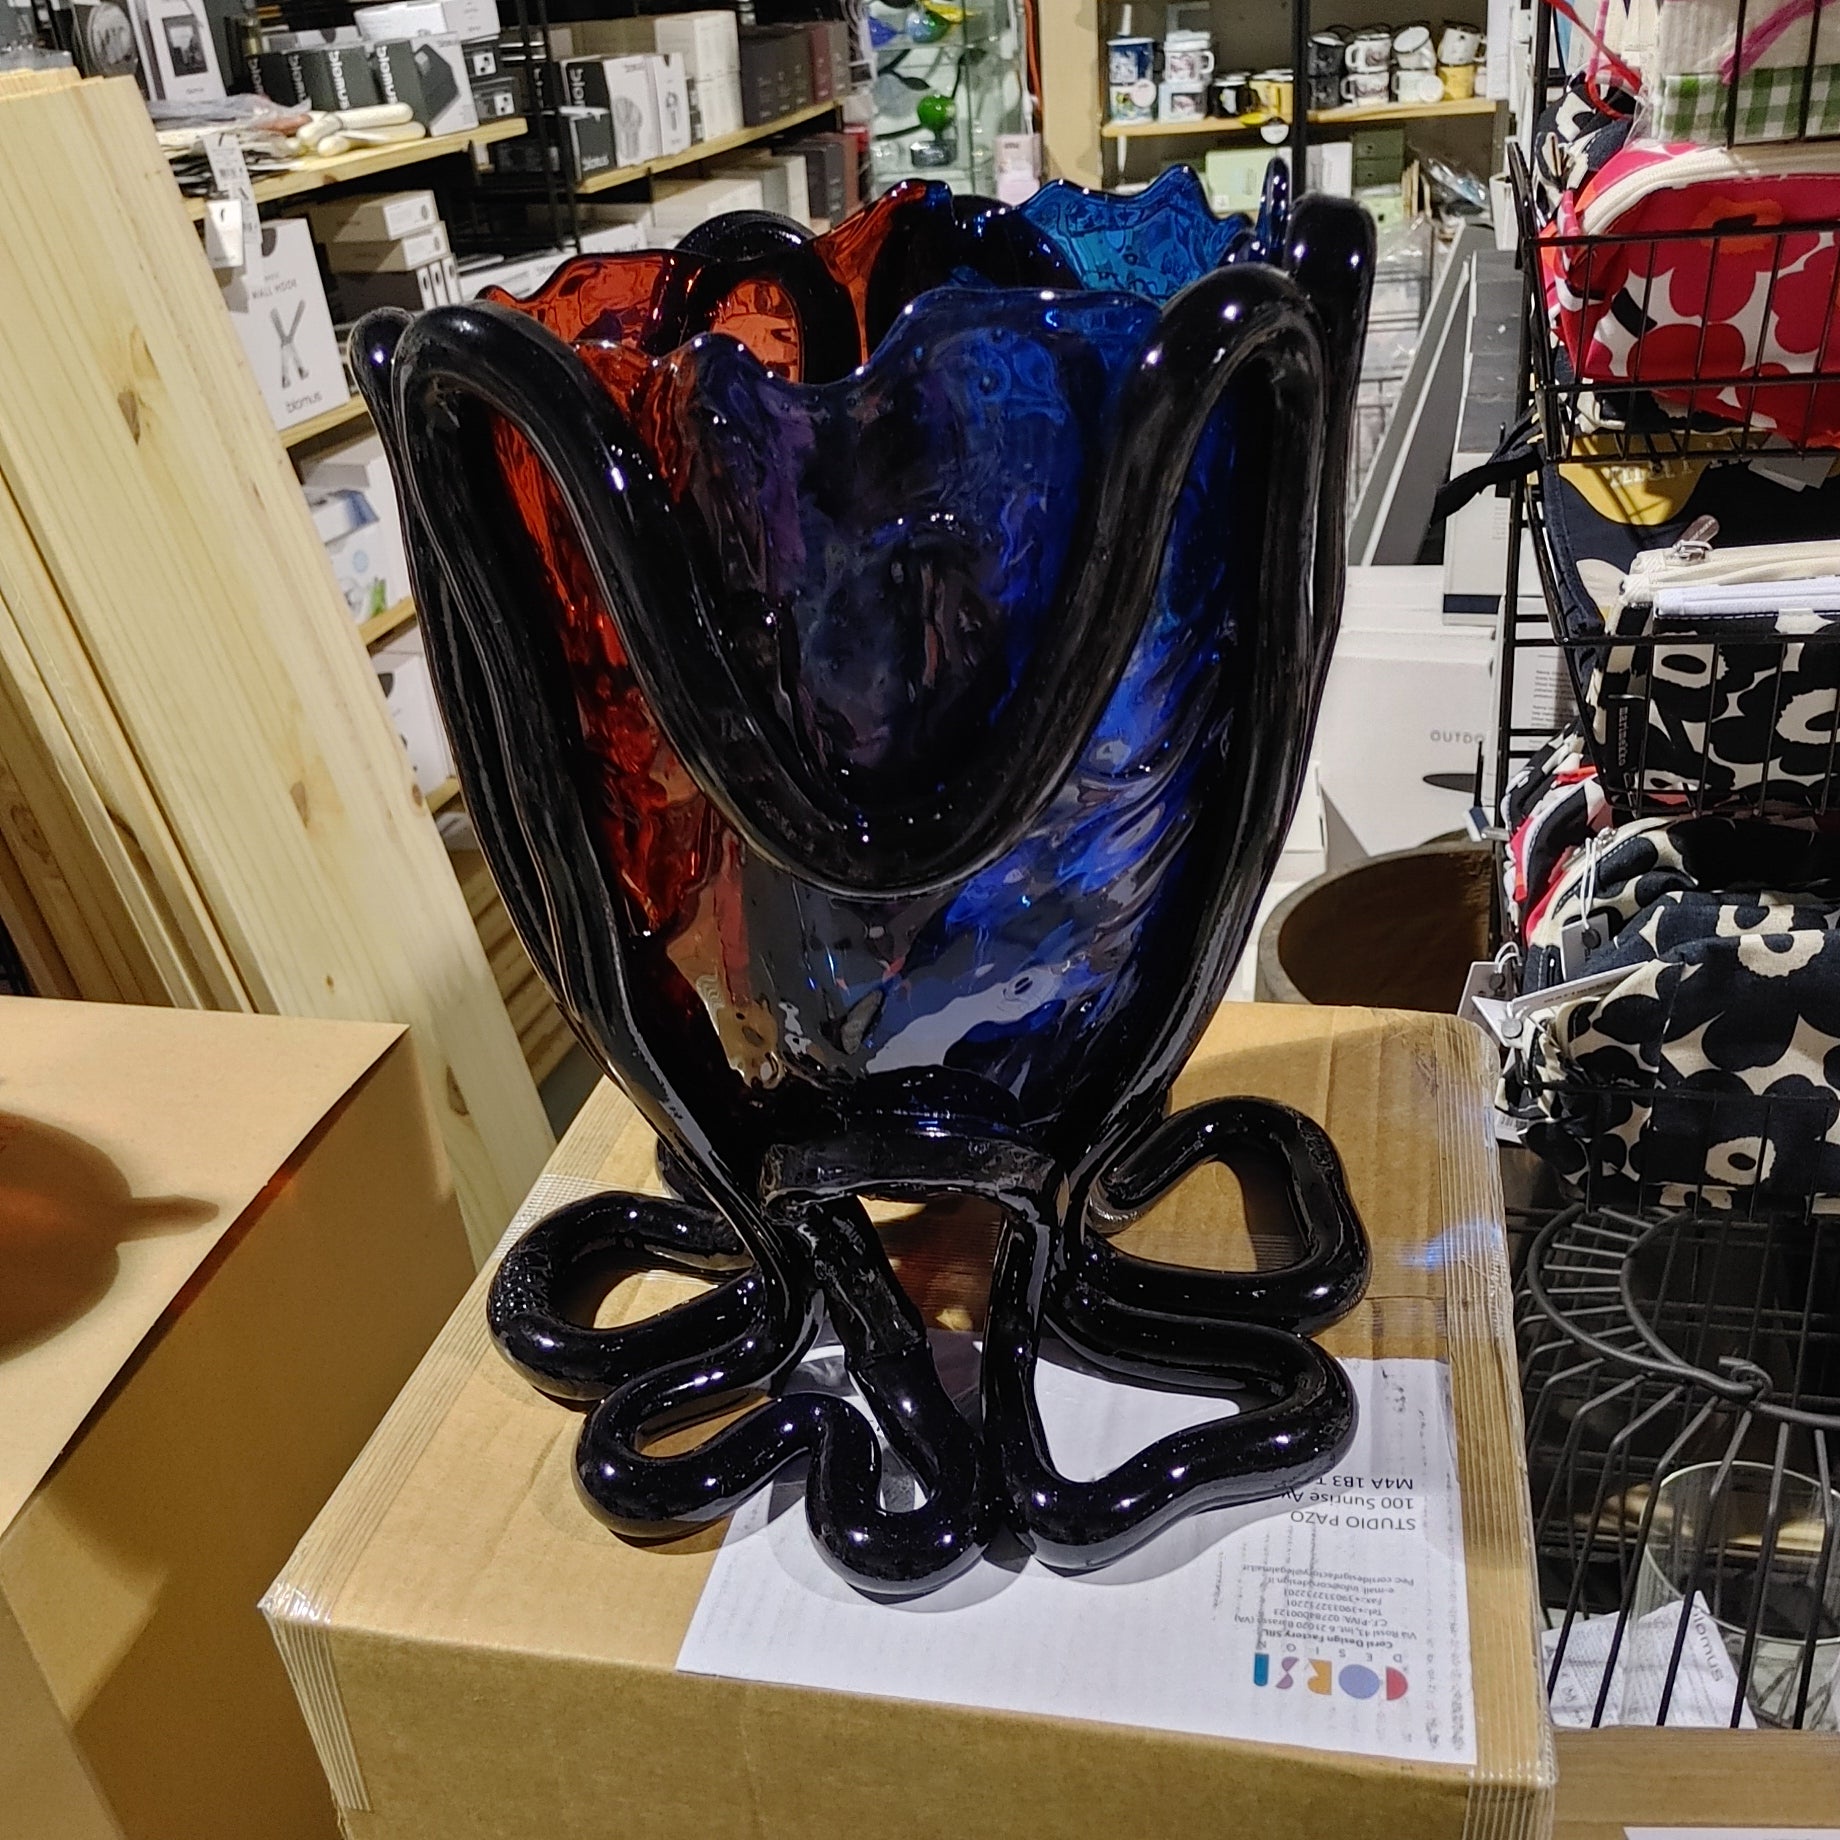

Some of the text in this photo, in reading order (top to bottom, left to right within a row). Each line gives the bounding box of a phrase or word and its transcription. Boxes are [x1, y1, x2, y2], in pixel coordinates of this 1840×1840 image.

[248, 57, 264, 94] blom
[288, 54, 306, 102] blomu
[329, 50, 350, 110] blomus
[285, 392, 323, 413] blomus
[1333, 1475, 1364, 1488] 1B3
[1371, 1478, 1413, 1490] M4A
[1279, 1486, 1414, 1510] 100 Sunrise Av
[1290, 1510, 1416, 1530] STUDIO PAZO
[1284, 1629, 1325, 1643] Factory
[1327, 1634, 1364, 1648] Design
[1366, 1640, 1393, 1649] Corsi
[1692, 1610, 1724, 1682] lomus
[1254, 1653, 1408, 1700] CORSI
